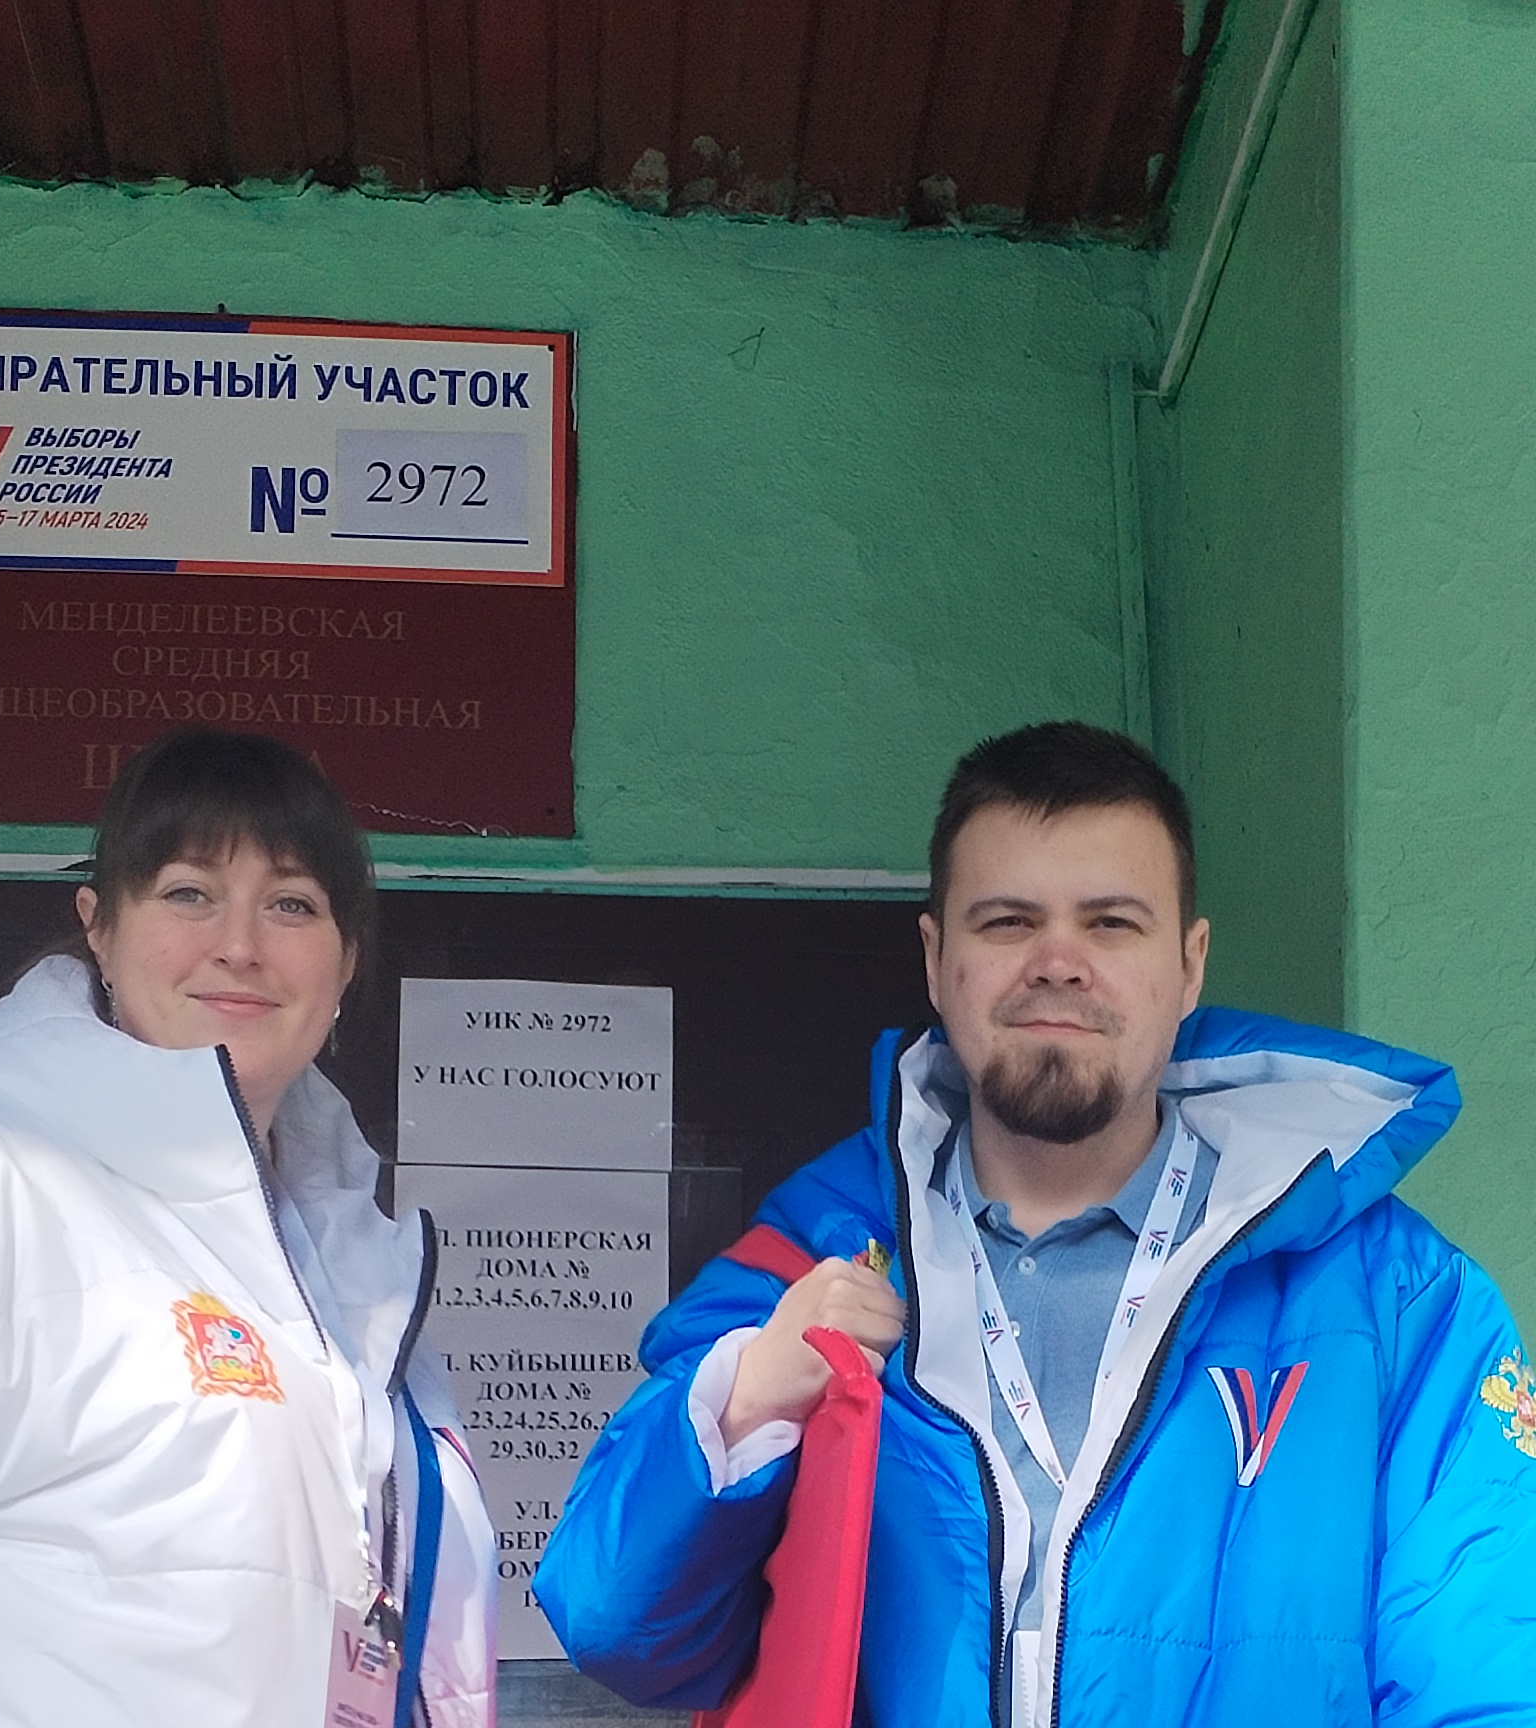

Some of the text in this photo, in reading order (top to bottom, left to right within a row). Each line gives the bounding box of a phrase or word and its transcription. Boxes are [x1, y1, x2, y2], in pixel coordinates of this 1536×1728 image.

[316, 362, 530, 409] УЧАСТОК
[24, 426, 140, 450] ВЫБОРЫ
[11, 455, 173, 480] ПРЕЗИДЕНТА
[366, 461, 489, 508] 2972
[39, 510, 101, 531] МАРТА
[104, 511, 149, 531] 2024
[20, 600, 405, 640] МЕНДЕЛЕЕВСКАЯ
[111, 644, 311, 682] СРЕДНЯЯ
[466, 1011, 612, 1033] УИК № 2972
[413, 1065, 662, 1092] У НАС ГОЛОСУЮТ
[435, 1228, 652, 1252] Л. ПИОНЕРСКАЯ
[476, 1258, 590, 1281] ДОМА №
[469, 1348, 642, 1374] КУЙБЫШЕВ
[477, 1382, 592, 1403] ДОМА №
[490, 1440, 580, 1462] 29,30,32
[514, 1500, 559, 1520] УЛ.
[495, 1531, 554, 1551] БЕР
